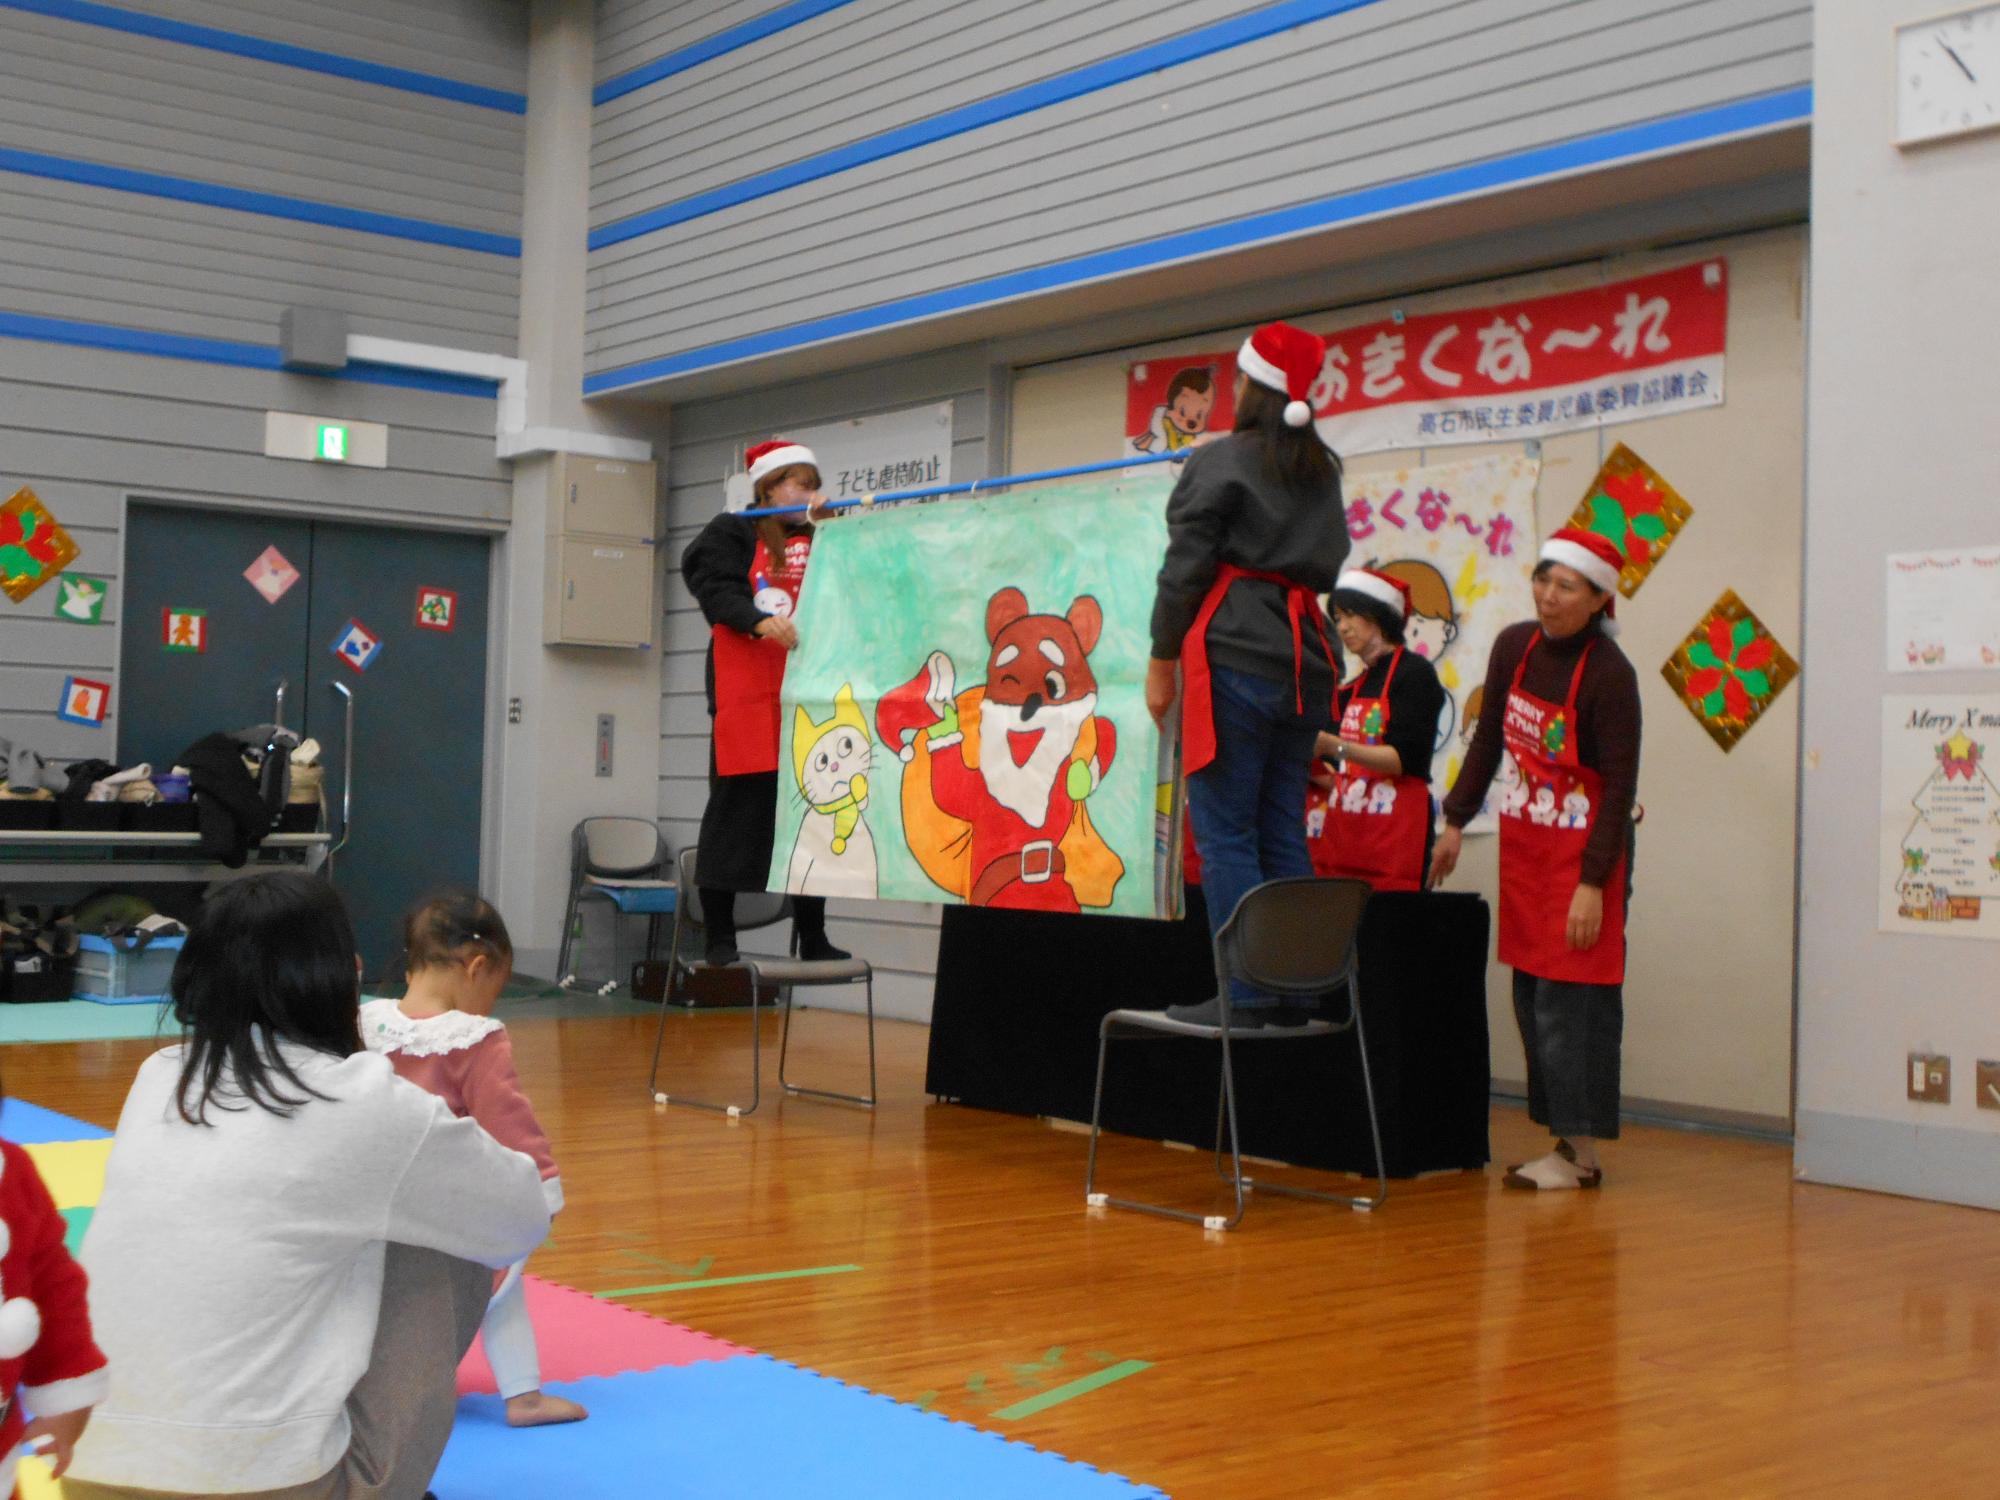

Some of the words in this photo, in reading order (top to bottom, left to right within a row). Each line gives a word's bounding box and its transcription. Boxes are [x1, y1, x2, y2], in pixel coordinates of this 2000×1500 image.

[836, 453, 940, 496] 子ども虐待防止
[1905, 708, 1957, 734] Merry
